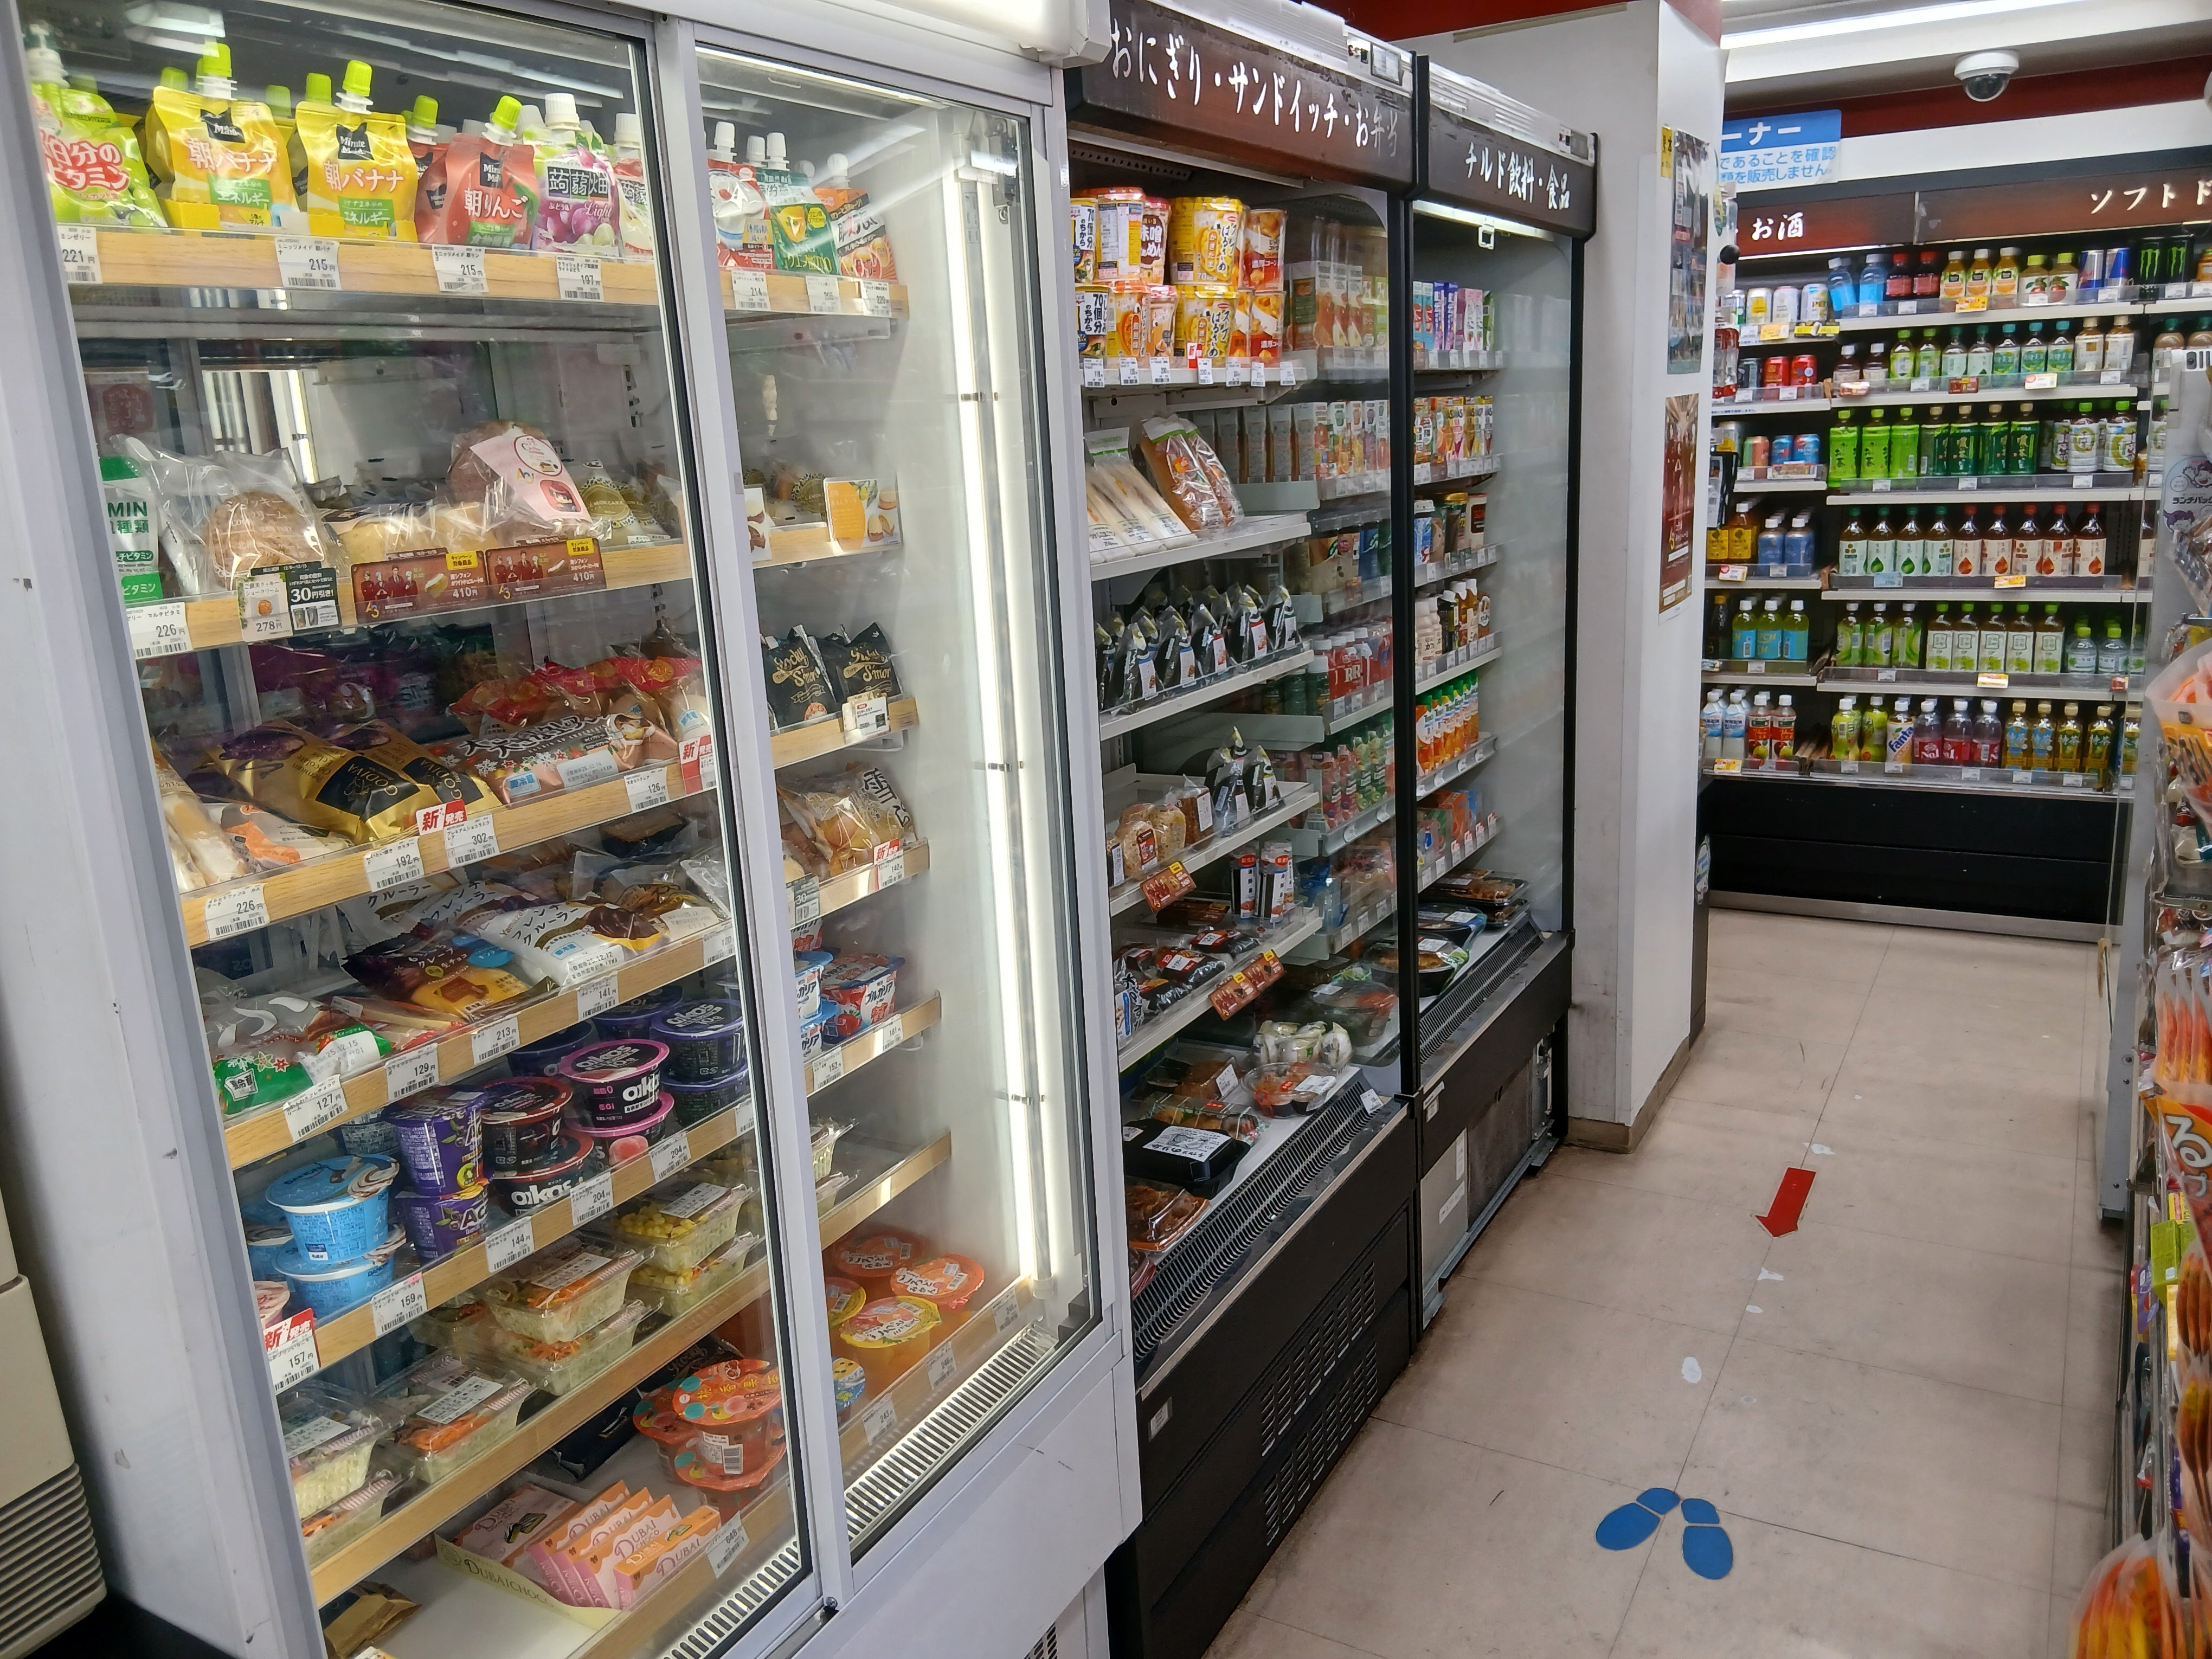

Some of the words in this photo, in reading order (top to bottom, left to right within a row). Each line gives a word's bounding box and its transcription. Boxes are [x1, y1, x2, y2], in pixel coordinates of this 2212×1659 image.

[187, 140, 278, 174] 朝バナナ
[324, 159, 404, 192] 朝バナナ
[548, 168, 609, 197] 蒟蒻畑
[217, 190, 269, 205] エネルギー
[464, 187, 529, 218] 朝りんご
[344, 211, 390, 223] エネルギー
[583, 200, 613, 219] Light
[1752, 211, 1804, 241] お酒
[1084, 305, 1093, 332] のちから
[1092, 294, 1104, 333] 70個分
[1208, 312, 1221, 358] はるさめ
[573, 571, 595, 582] 410円
[452, 586, 478, 599] 410円
[156, 625, 186, 639] 226円
[682, 742, 695, 760] 新
[422, 809, 439, 832] 新
[472, 832, 494, 845] 302円
[236, 900, 264, 914] 226円
[599, 987, 617, 999] 141円
[496, 1026, 517, 1041] 213円
[414, 1063, 435, 1076] 129円
[317, 1093, 341, 1111] 127円
[511, 1234, 531, 1248] 144円
[400, 1293, 422, 1307] 159円
[288, 1351, 313, 1369] 157円
[569, 1503, 612, 1542] DUBAI
[614, 1520, 656, 1559] DUBAI
[655, 1538, 700, 1577] DUBAI
